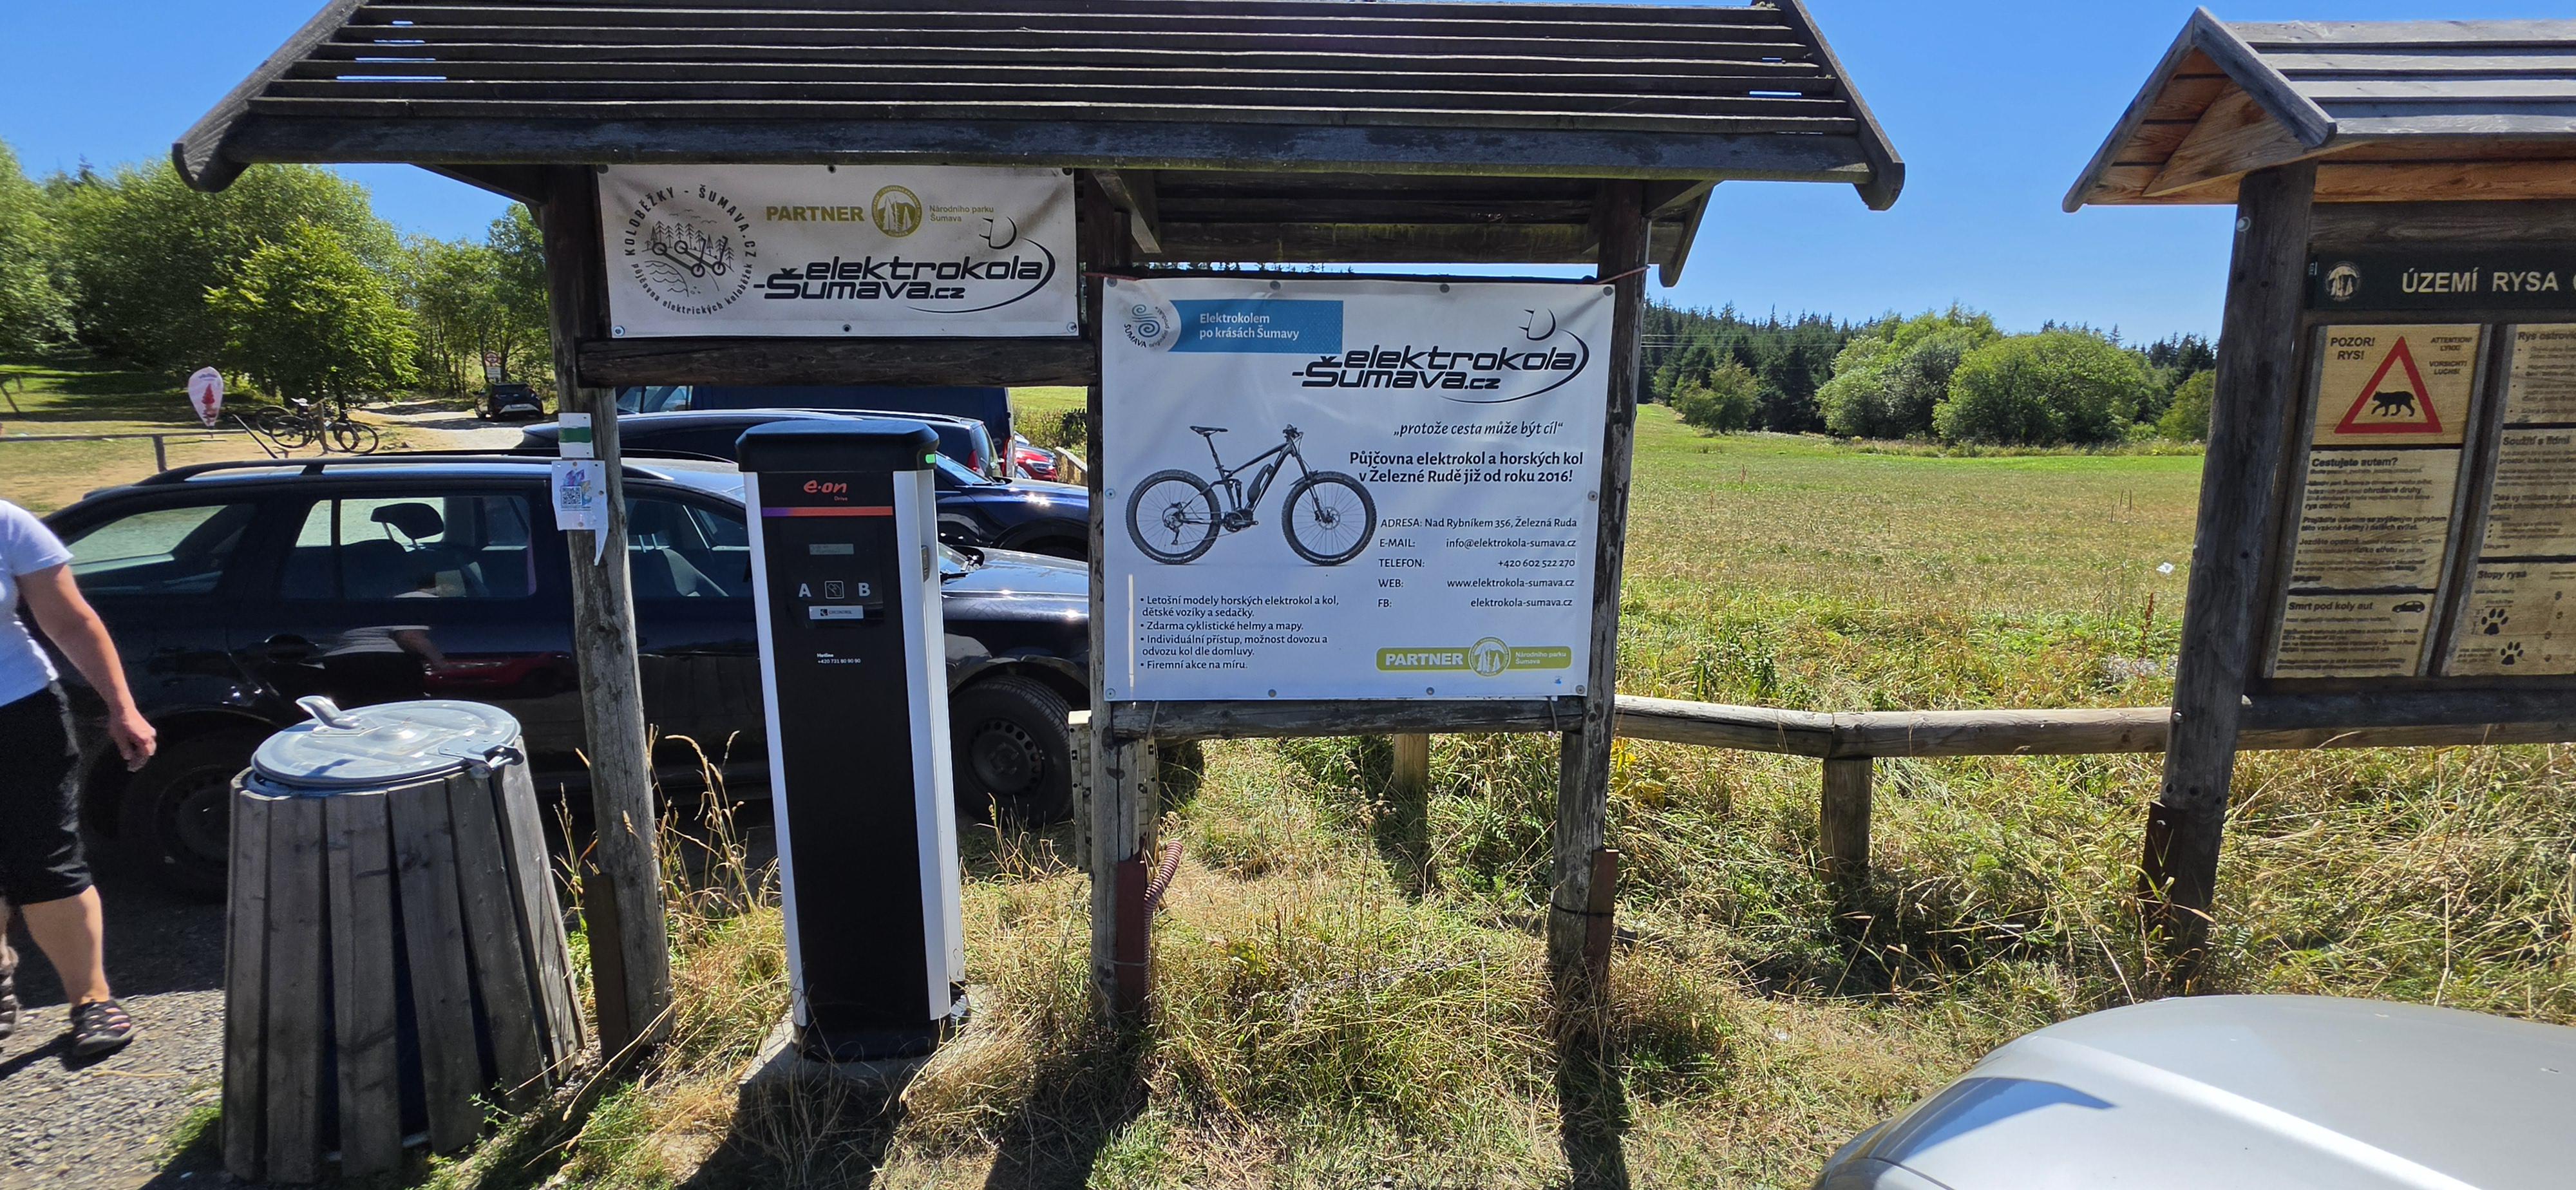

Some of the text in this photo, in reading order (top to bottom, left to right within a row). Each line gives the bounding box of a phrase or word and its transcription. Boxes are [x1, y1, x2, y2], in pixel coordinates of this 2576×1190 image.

[766, 206, 864, 221] PARTNER
[929, 205, 969, 215] Národního
[625, 187, 674, 256] KOLOBĚŽKY
[699, 184, 757, 258] ŠUMAVA.CZ
[931, 212, 961, 222] Šumava
[806, 256, 1043, 279] elektrokola
[2403, 267, 2559, 292] ÚZEMÍ RYSA
[631, 263, 753, 315] půjčovna elektrických koloběžek
[1200, 312, 1270, 325] Elektrokolem
[1200, 325, 1299, 341] po krásách Šumavy
[2518, 332, 2536, 342] Rys
[2330, 337, 2376, 348] POZOR!
[1344, 345, 1577, 370] elektrokola
[2337, 350, 2365, 361] RYS!
[1452, 424, 1482, 434] cesta
[1484, 421, 1517, 434] může
[1521, 421, 1541, 437] být
[1350, 451, 1583, 469] Půjčovna elektrokol a horských kol
[2312, 458, 2358, 468] Cestujete
[1359, 468, 1572, 484] v Železné Rudě již od roku 2016!
[1381, 516, 1577, 529] ADRESA: Nad Rybníkem 356, Železná Ruda
[1446, 538, 1576, 549] info@elektrokola-sumava.cz
[1379, 559, 1425, 567] TELEFON:
[2477, 571, 2505, 580] Stopy
[1378, 578, 1574, 587] WEB: www.elektrokola-sumava.cz
[799, 583, 870, 598] A B
[1148, 596, 1181, 604] Letošní
[1184, 596, 1218, 606] modely
[1221, 596, 1262, 607] horských
[1265, 596, 1312, 605] elektrokol
[1323, 596, 1338, 605] kol,
[1378, 598, 1572, 607] FB: elektrokola-sumava.cz
[2288, 601, 2313, 610] Smrt
[2313, 602, 2333, 612] pod
[2335, 602, 2355, 612] koly
[1142, 607, 1174, 617] dětské
[1176, 607, 1206, 619] vozíky
[1214, 607, 1254, 619] sedačky.
[1186, 621, 1235, 632] cyklistické
[1237, 621, 1266, 632] helmy
[1276, 623, 1303, 632] mapy.
[1147, 634, 1204, 644] Individuální
[1207, 634, 1242, 646] přístup,
[1245, 635, 1285, 643] možnost
[1287, 634, 1320, 643] dovozu
[1143, 646, 1254, 657] odvozu kol dle domluvy.
[1148, 660, 1183, 669] Firemní
[1185, 660, 1207, 669] akce
[1223, 660, 1247, 668] míru.
[1386, 654, 1463, 665] PARTNER
